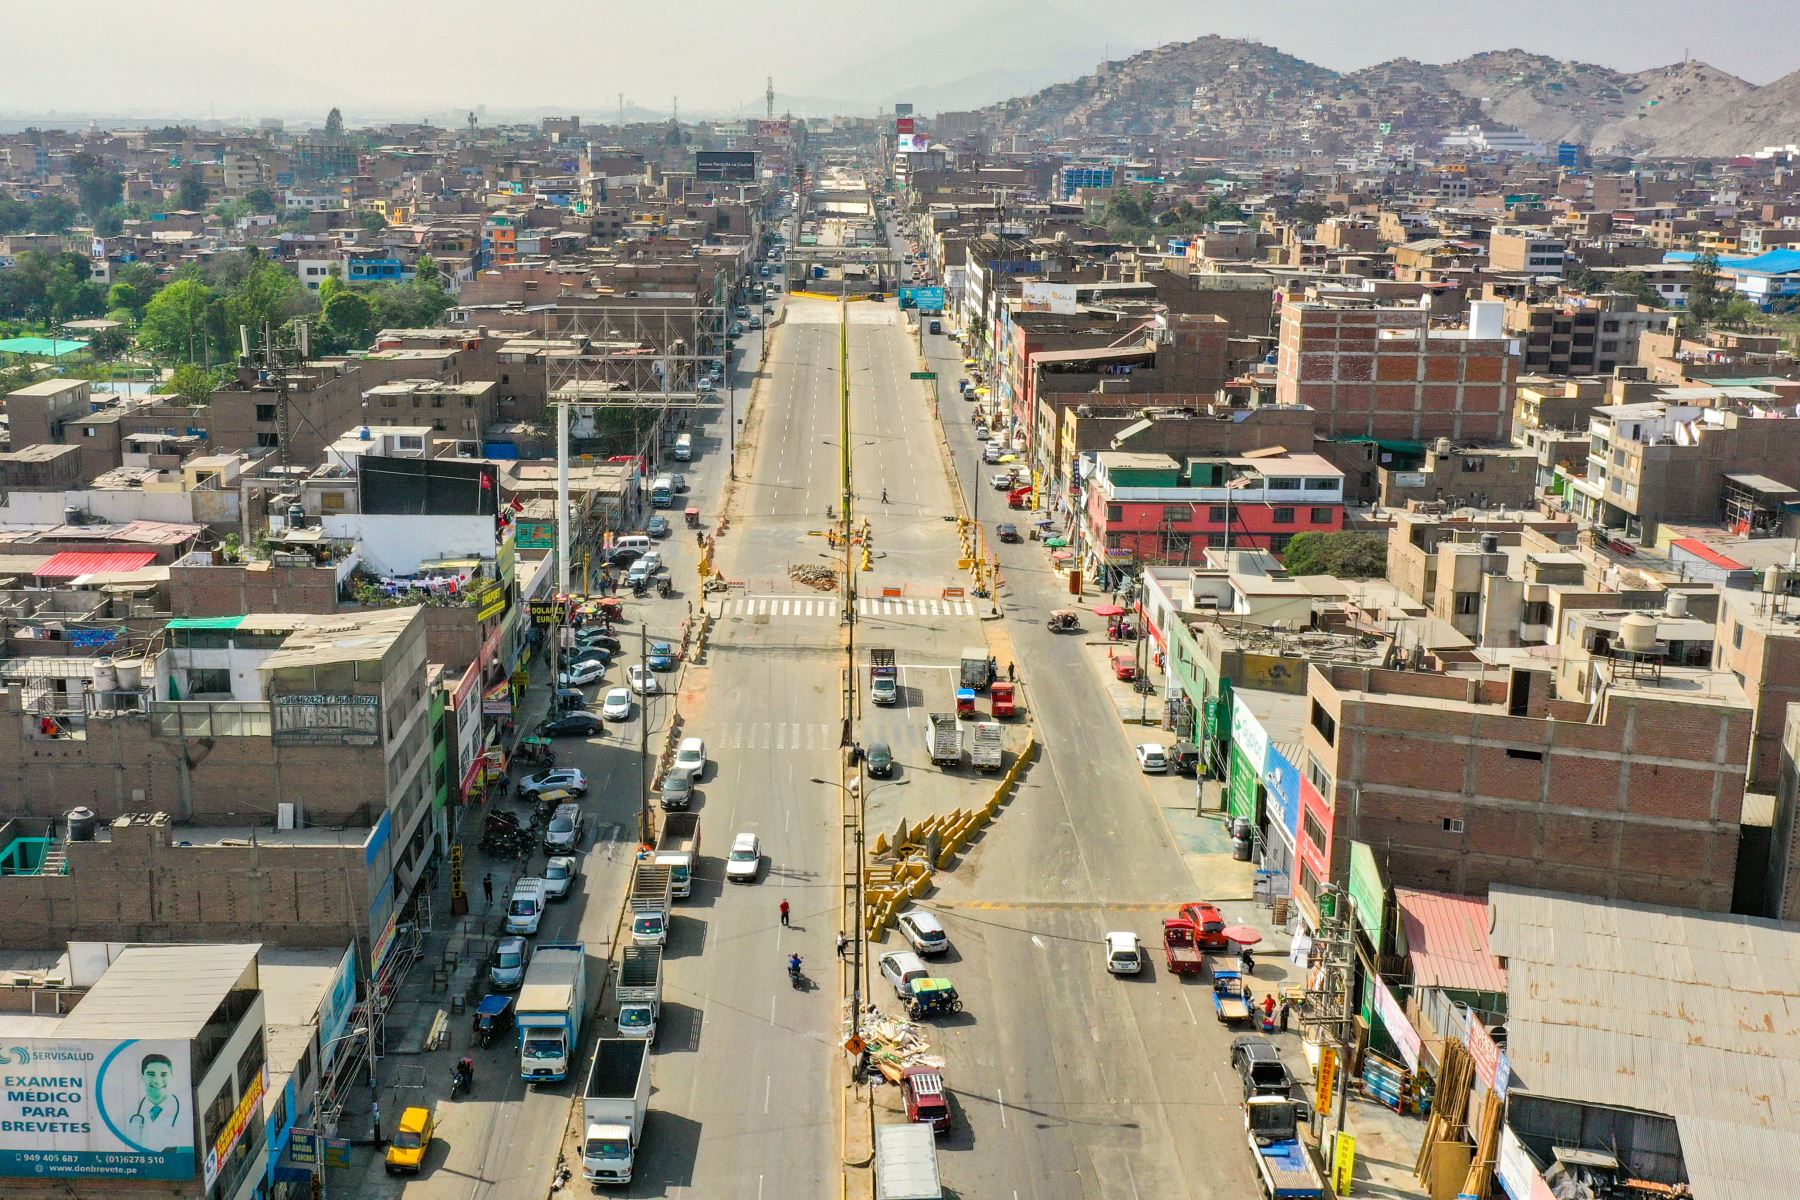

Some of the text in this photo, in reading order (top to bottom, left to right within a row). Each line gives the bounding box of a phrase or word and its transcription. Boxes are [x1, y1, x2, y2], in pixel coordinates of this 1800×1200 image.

[274, 705, 377, 732] INVASORES
[452, 847, 461, 897] PARQUET
[33, 1051, 93, 1061] SERVISALUD
[5, 1076, 82, 1087] EXAMEN
[1319, 1049, 1333, 1113] FERRETERIA
[8, 1089, 82, 1103] MÉDICO
[22, 1107, 69, 1118] PARA
[2, 1122, 91, 1133] BREVETES
[105, 1155, 145, 1164] (01)6278
[50, 1165, 137, 1173] www.donbrevete.pe
